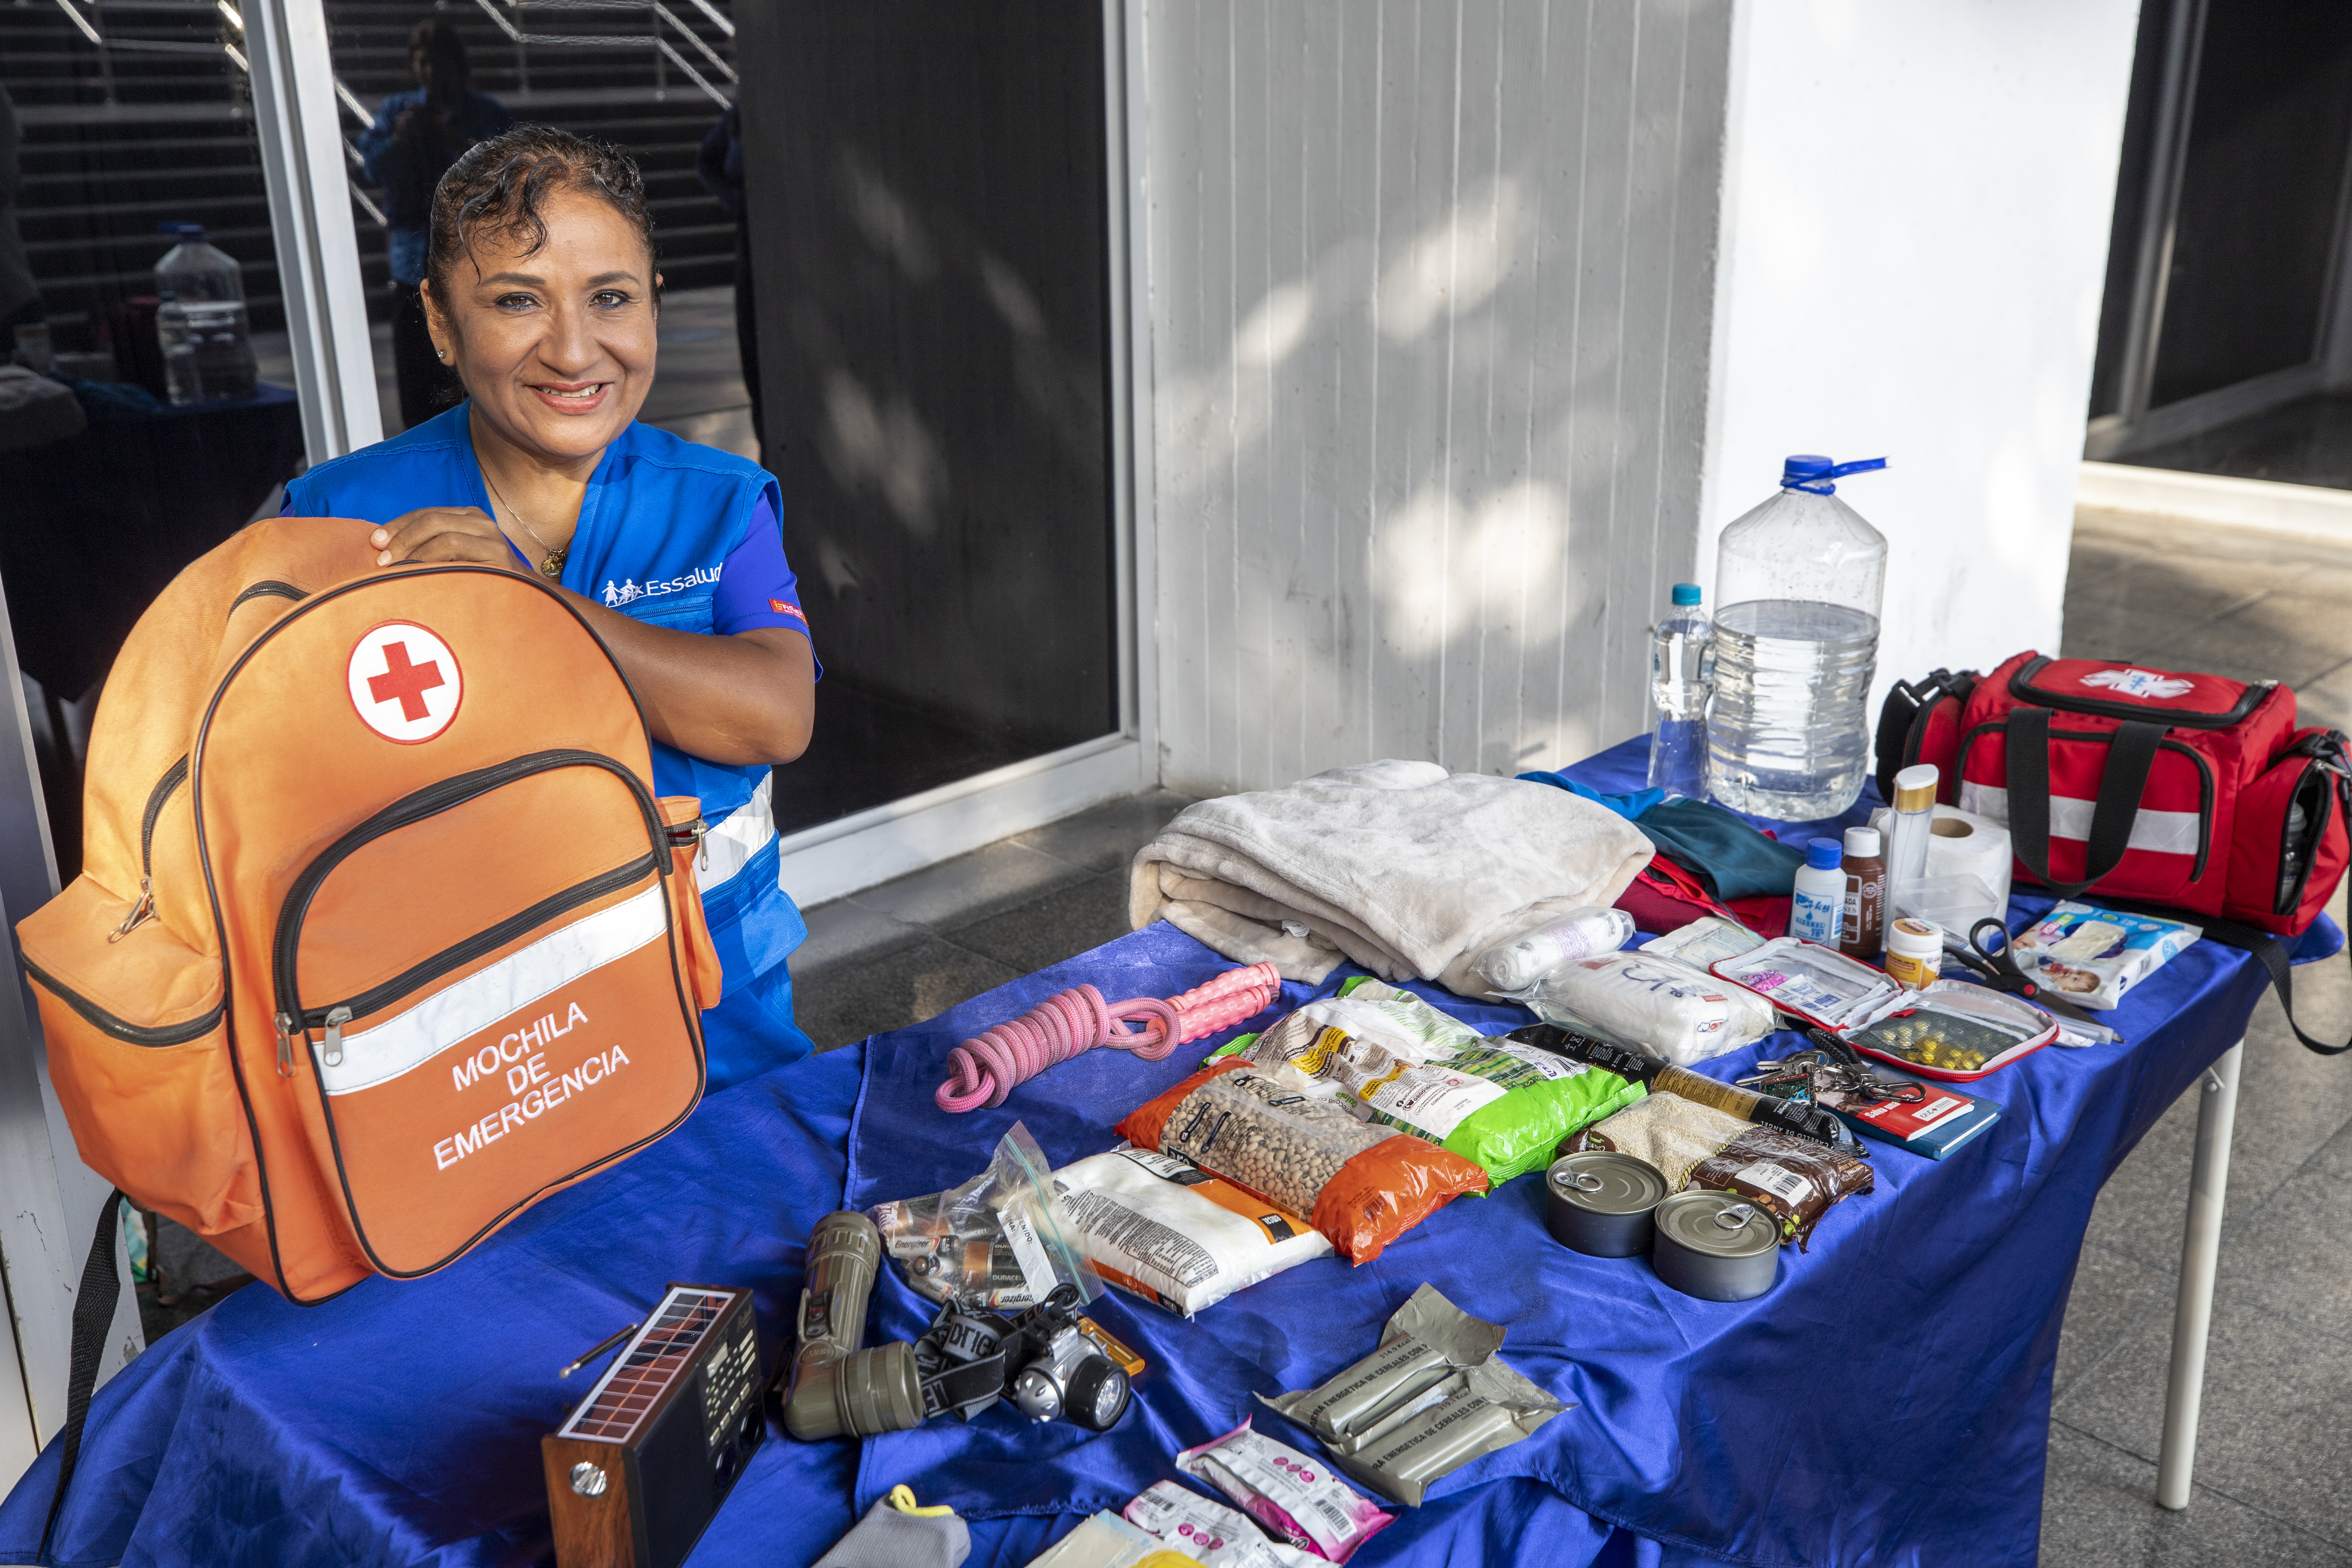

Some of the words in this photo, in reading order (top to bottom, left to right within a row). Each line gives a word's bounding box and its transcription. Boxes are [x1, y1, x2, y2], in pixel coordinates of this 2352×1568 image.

[1796, 916, 1825, 928] ALCOHOL
[452, 1002, 588, 1091] MOCHILA
[507, 1052, 551, 1096] DE
[1430, 1091, 1447, 1106] CONSUMIR
[433, 1045, 630, 1170] EMERGENCIA
[1777, 1102, 1792, 1115] alicorp
[1864, 1106, 1885, 1118] Salva
[1883, 1101, 1902, 1111] una
[1797, 1133, 1829, 1147] CABELLO
[894, 1239, 930, 1249] Energizer
[1396, 1337, 1411, 1349] Kcal
[1323, 1378, 1368, 1407] ENERGETICA
[1364, 1372, 1378, 1382] DE
[1375, 1354, 1409, 1376] CEREALES
[1406, 1345, 1424, 1357] CON
[1382, 1432, 1427, 1461] ENERGETICA
[1424, 1426, 1436, 1436] DE
[1434, 1406, 1470, 1430] CEREALES
[1467, 1396, 1484, 1409] CON
